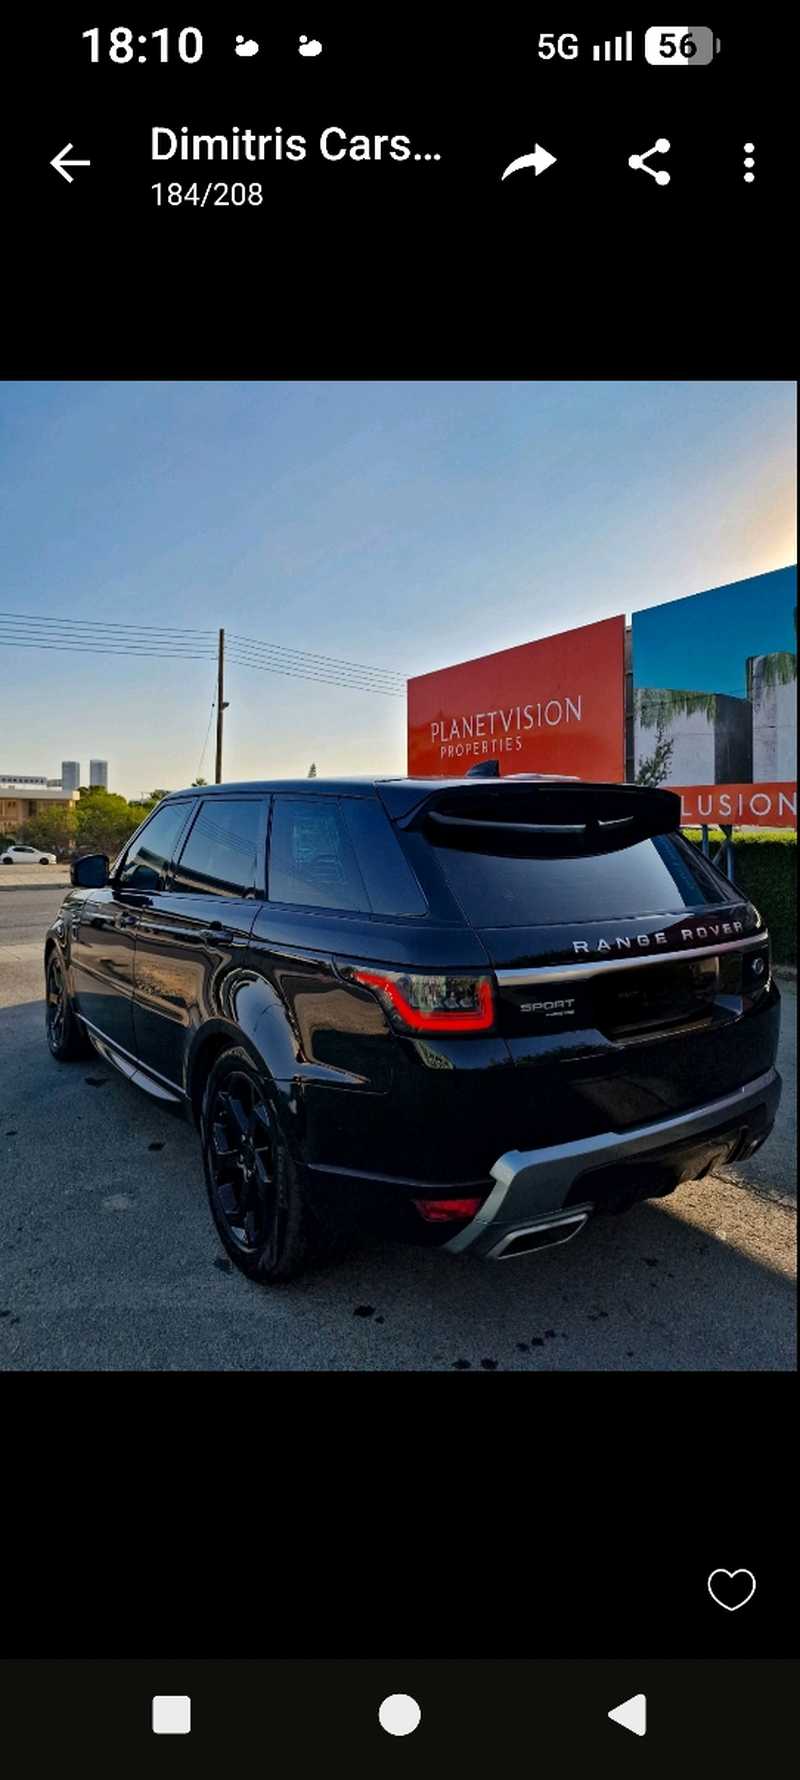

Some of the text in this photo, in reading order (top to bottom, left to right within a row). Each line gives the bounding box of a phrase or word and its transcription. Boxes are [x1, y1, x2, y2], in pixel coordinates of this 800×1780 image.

[431, 696, 582, 743] PLANETVISION
[440, 736, 523, 759] PROPERTIES
[572, 921, 743, 953] RANGE ROVER
[520, 998, 576, 1012] SPORT
